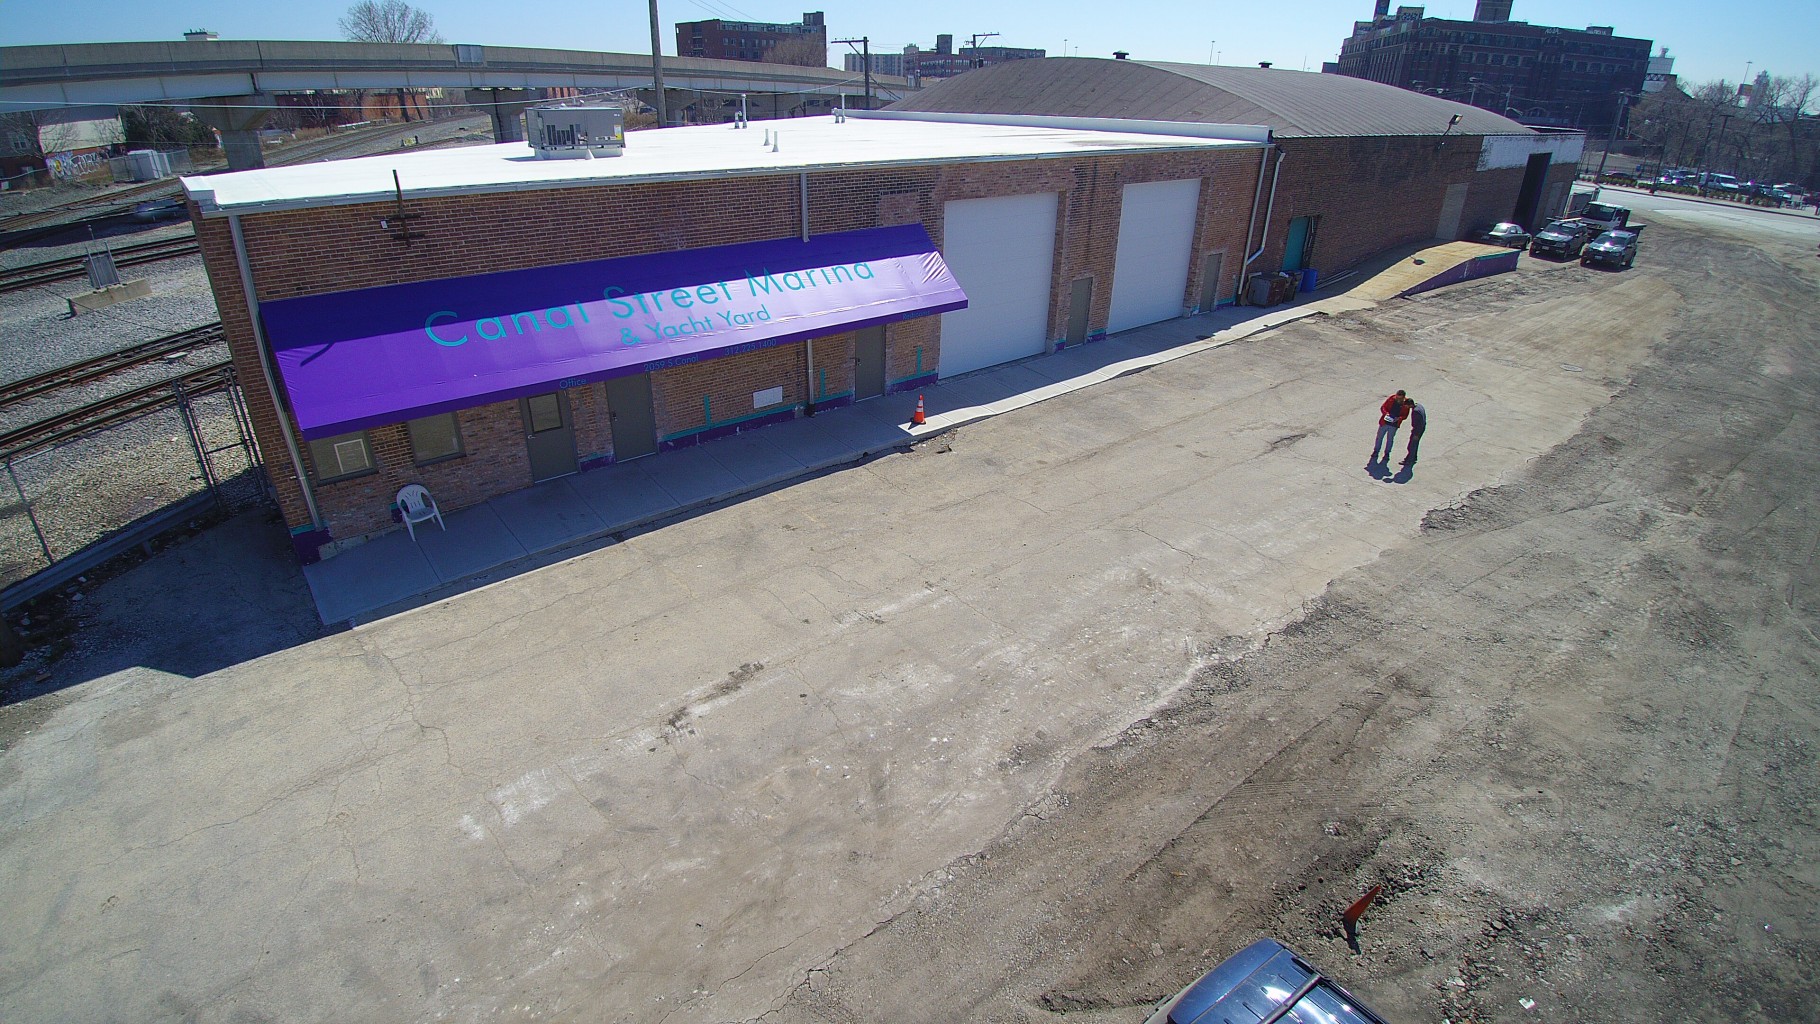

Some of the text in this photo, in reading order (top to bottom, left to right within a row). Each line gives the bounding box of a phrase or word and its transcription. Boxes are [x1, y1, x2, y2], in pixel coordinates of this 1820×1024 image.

[425, 261, 875, 347] Canal Street Marina
[620, 304, 771, 346] & Yacht Yard
[724, 338, 777, 356] 312.225.1400
[643, 360, 665, 372] 2059
[675, 353, 699, 366] Canal
[559, 376, 587, 390] Office
